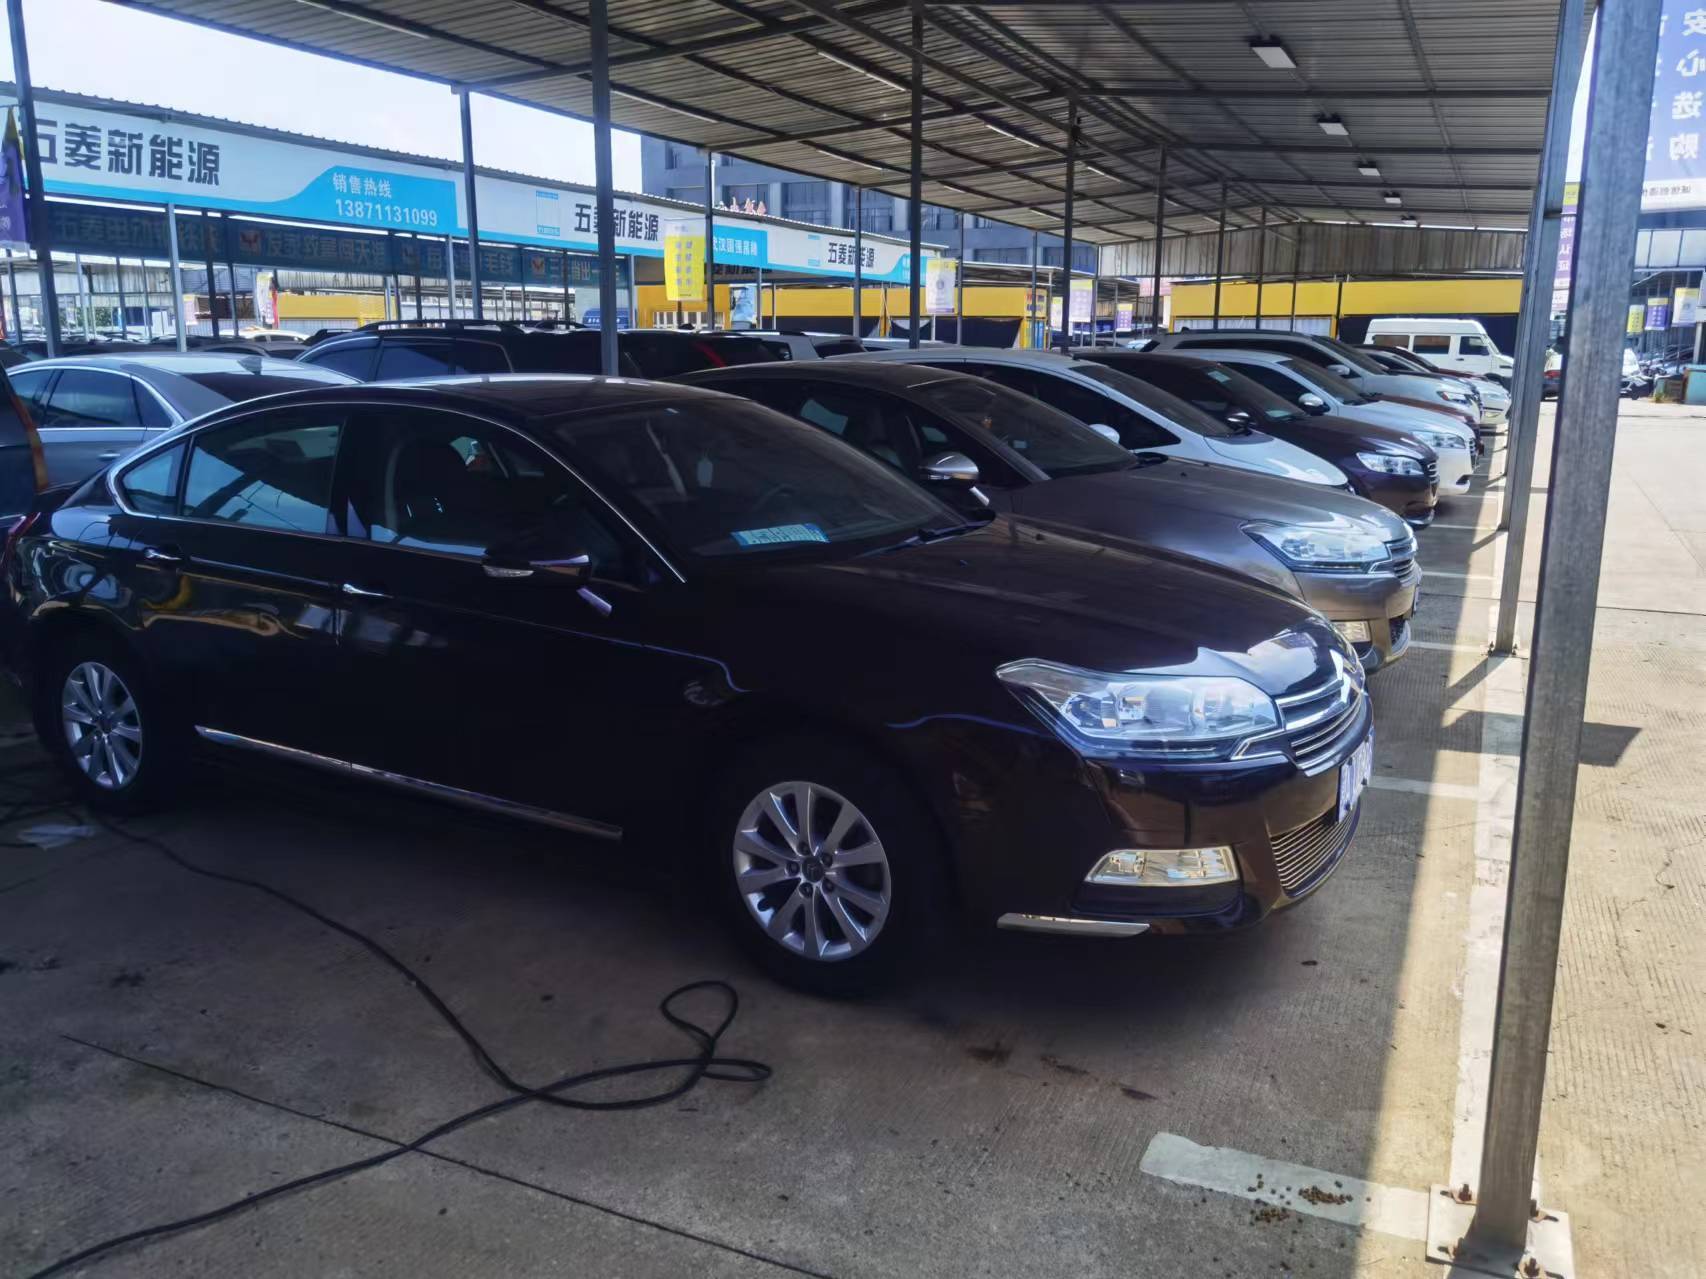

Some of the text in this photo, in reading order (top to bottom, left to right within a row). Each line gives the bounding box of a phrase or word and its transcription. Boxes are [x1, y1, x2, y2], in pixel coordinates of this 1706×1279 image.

[332, 172, 392, 199] 销售热线
[335, 198, 438, 226] 13871131099
[574, 203, 659, 242] 五新能源
